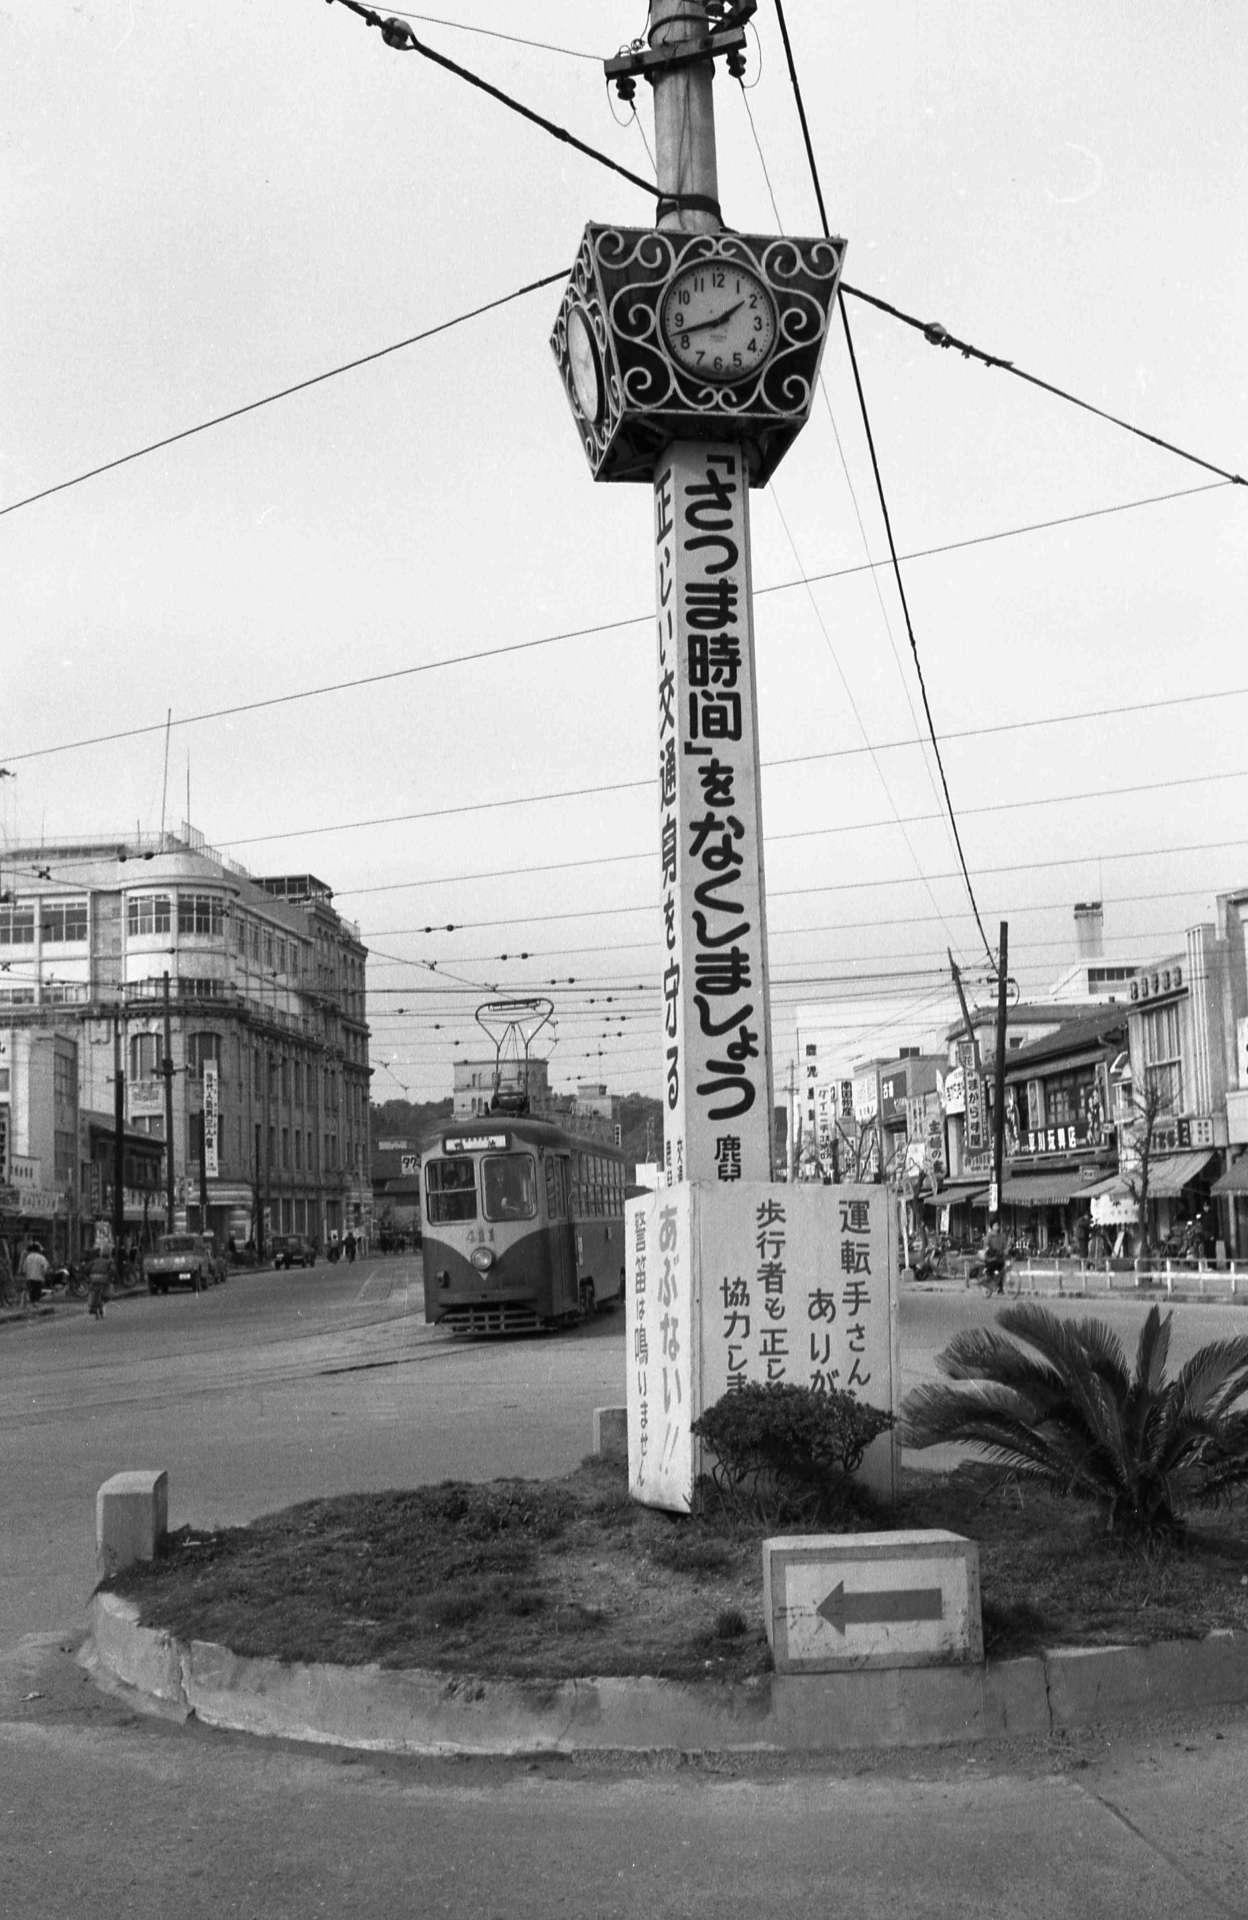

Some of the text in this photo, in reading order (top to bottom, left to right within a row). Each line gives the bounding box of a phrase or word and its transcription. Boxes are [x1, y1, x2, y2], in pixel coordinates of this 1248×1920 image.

[693, 277, 704, 292] 11
[712, 273, 725, 288] 12
[735, 279, 740, 293] 1
[677, 291, 690, 305] 10
[749, 294, 758, 309] 2
[674, 312, 684, 327] 9
[753, 316, 762, 330] 3
[681, 335, 690, 349] 8
[747, 338, 757, 353] 4
[695, 351, 706, 365] 7
[713, 356, 723, 370] 6
[733, 353, 742, 368] 5
[684, 454, 760, 1121] 「さつま時間」をなくしましょう
